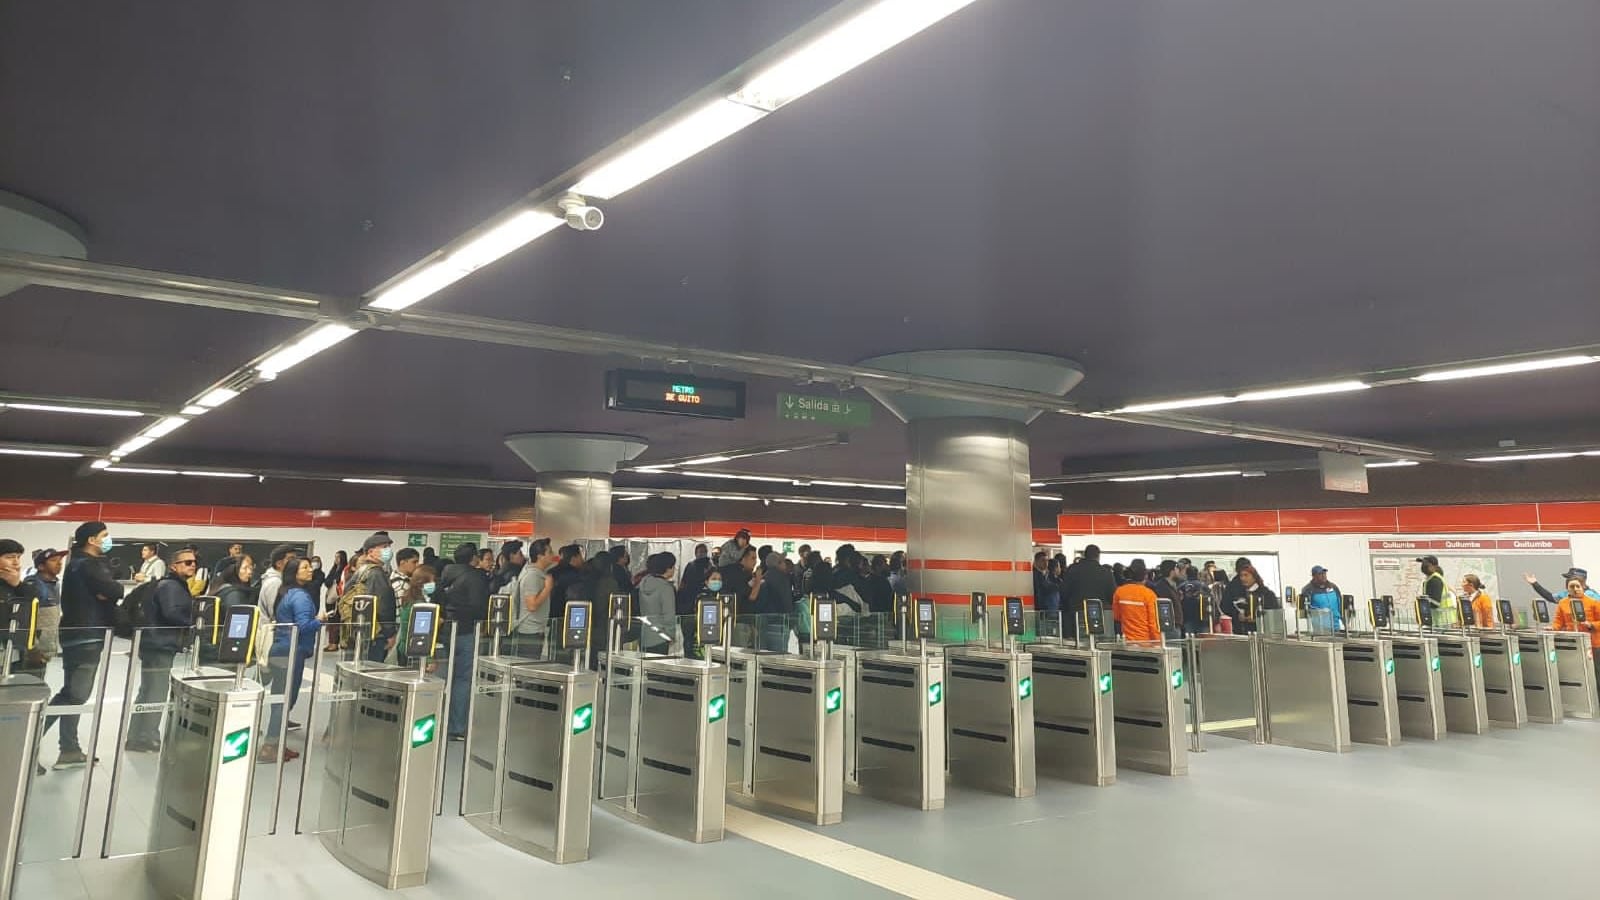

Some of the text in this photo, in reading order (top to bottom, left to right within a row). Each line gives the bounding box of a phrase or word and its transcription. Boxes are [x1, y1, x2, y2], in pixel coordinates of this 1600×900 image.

[672, 385, 694, 394] METRO
[665, 392, 700, 403] DE QUITO
[798, 397, 829, 411] Salida
[1128, 515, 1177, 527] Quitumbe
[1513, 540, 1552, 549] Quitumbe
